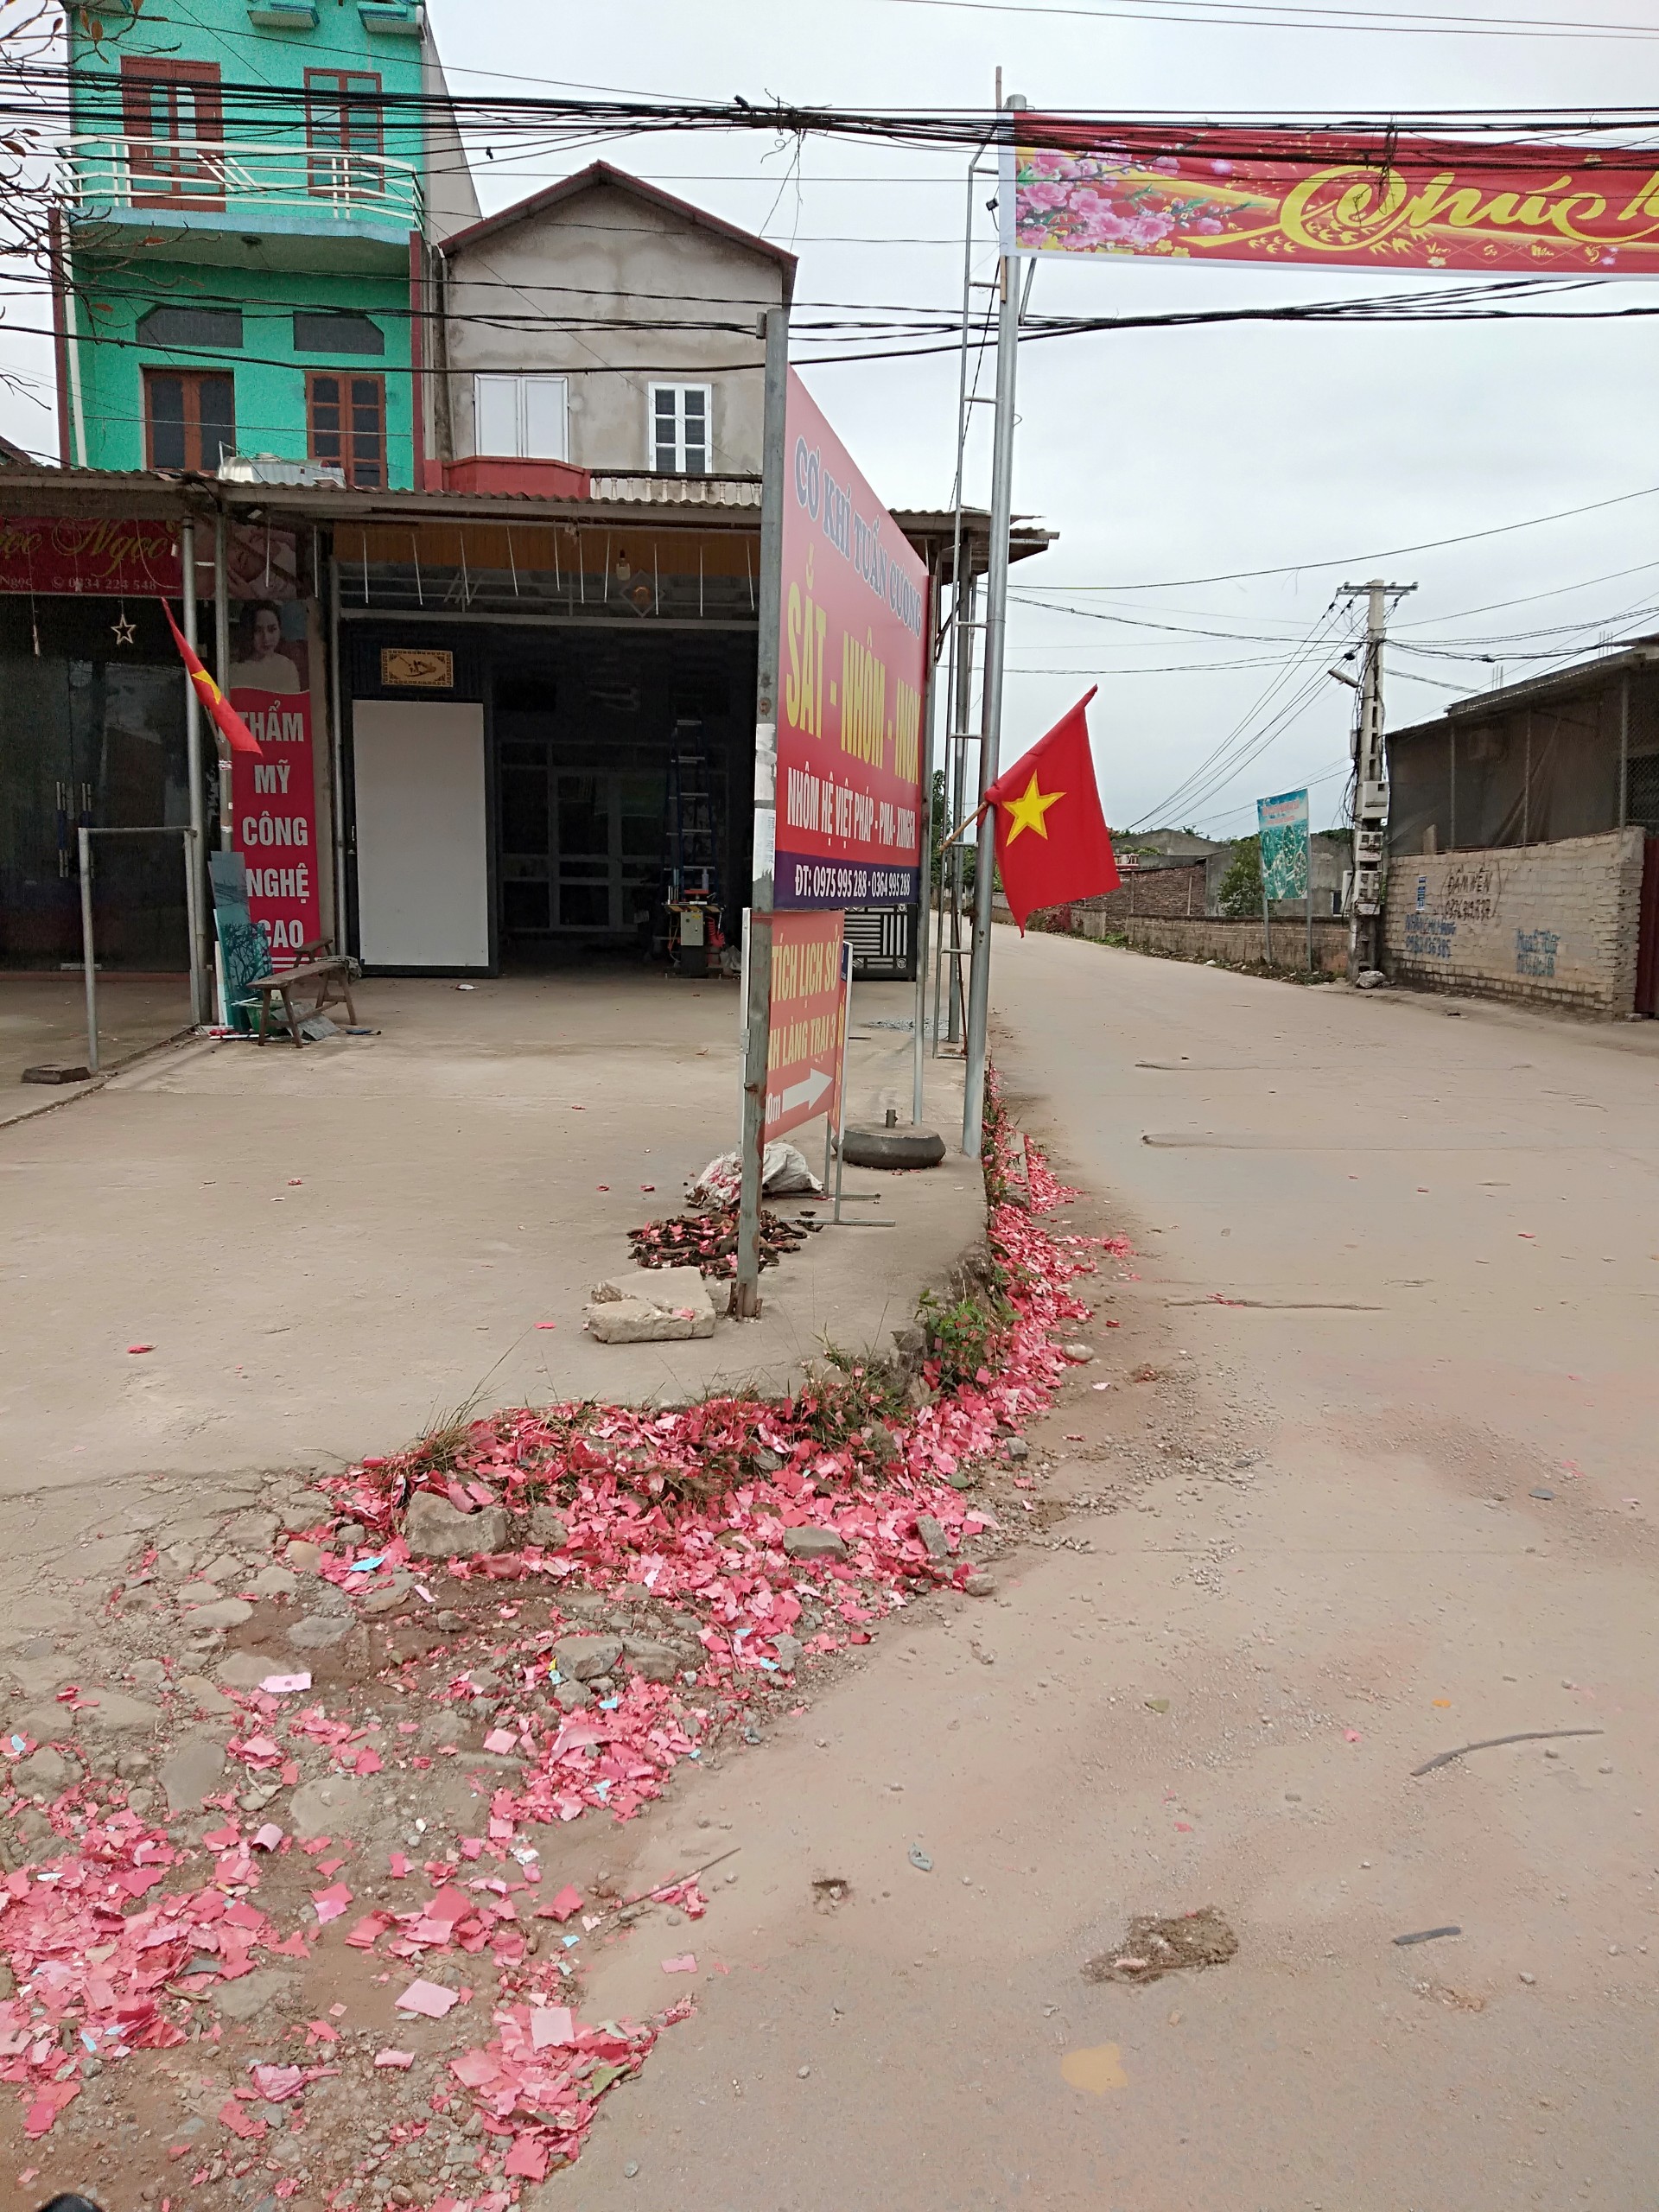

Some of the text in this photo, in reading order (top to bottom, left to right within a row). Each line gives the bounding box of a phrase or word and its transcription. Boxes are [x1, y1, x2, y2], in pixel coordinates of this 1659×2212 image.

[1184, 164, 1642, 252] Chúc
[795, 435, 821, 522] CƠ
[823, 468, 851, 562] KHÍ
[786, 542, 827, 740] SẮT
[841, 626, 886, 770] NHÔM
[895, 677, 921, 785] INOX
[254, 759, 291, 794] MỸ
[787, 760, 820, 831] NHÔM
[821, 771, 833, 847] HỆ
[835, 777, 854, 849] VIỆT
[854, 785, 874, 842] PHÁP
[242, 810, 308, 846] CÔNG
[246, 862, 310, 904] NGHỆ
[795, 864, 811, 898] ĐT:
[813, 866, 836, 898] 0975
[837, 868, 853, 898] 995
[853, 869, 868, 898] 288
[871, 870, 888, 897] 0364
[888, 872, 899, 897] 995
[899, 873, 911, 896] 288
[772, 932, 798, 1002] TÍCH
[799, 942, 823, 1009] LỊCH
[824, 924, 840, 992] SỬ
[782, 1015, 809, 1067] LÀNG
[810, 1014, 830, 1060] TRẠI
[830, 1013, 836, 1049] 3
